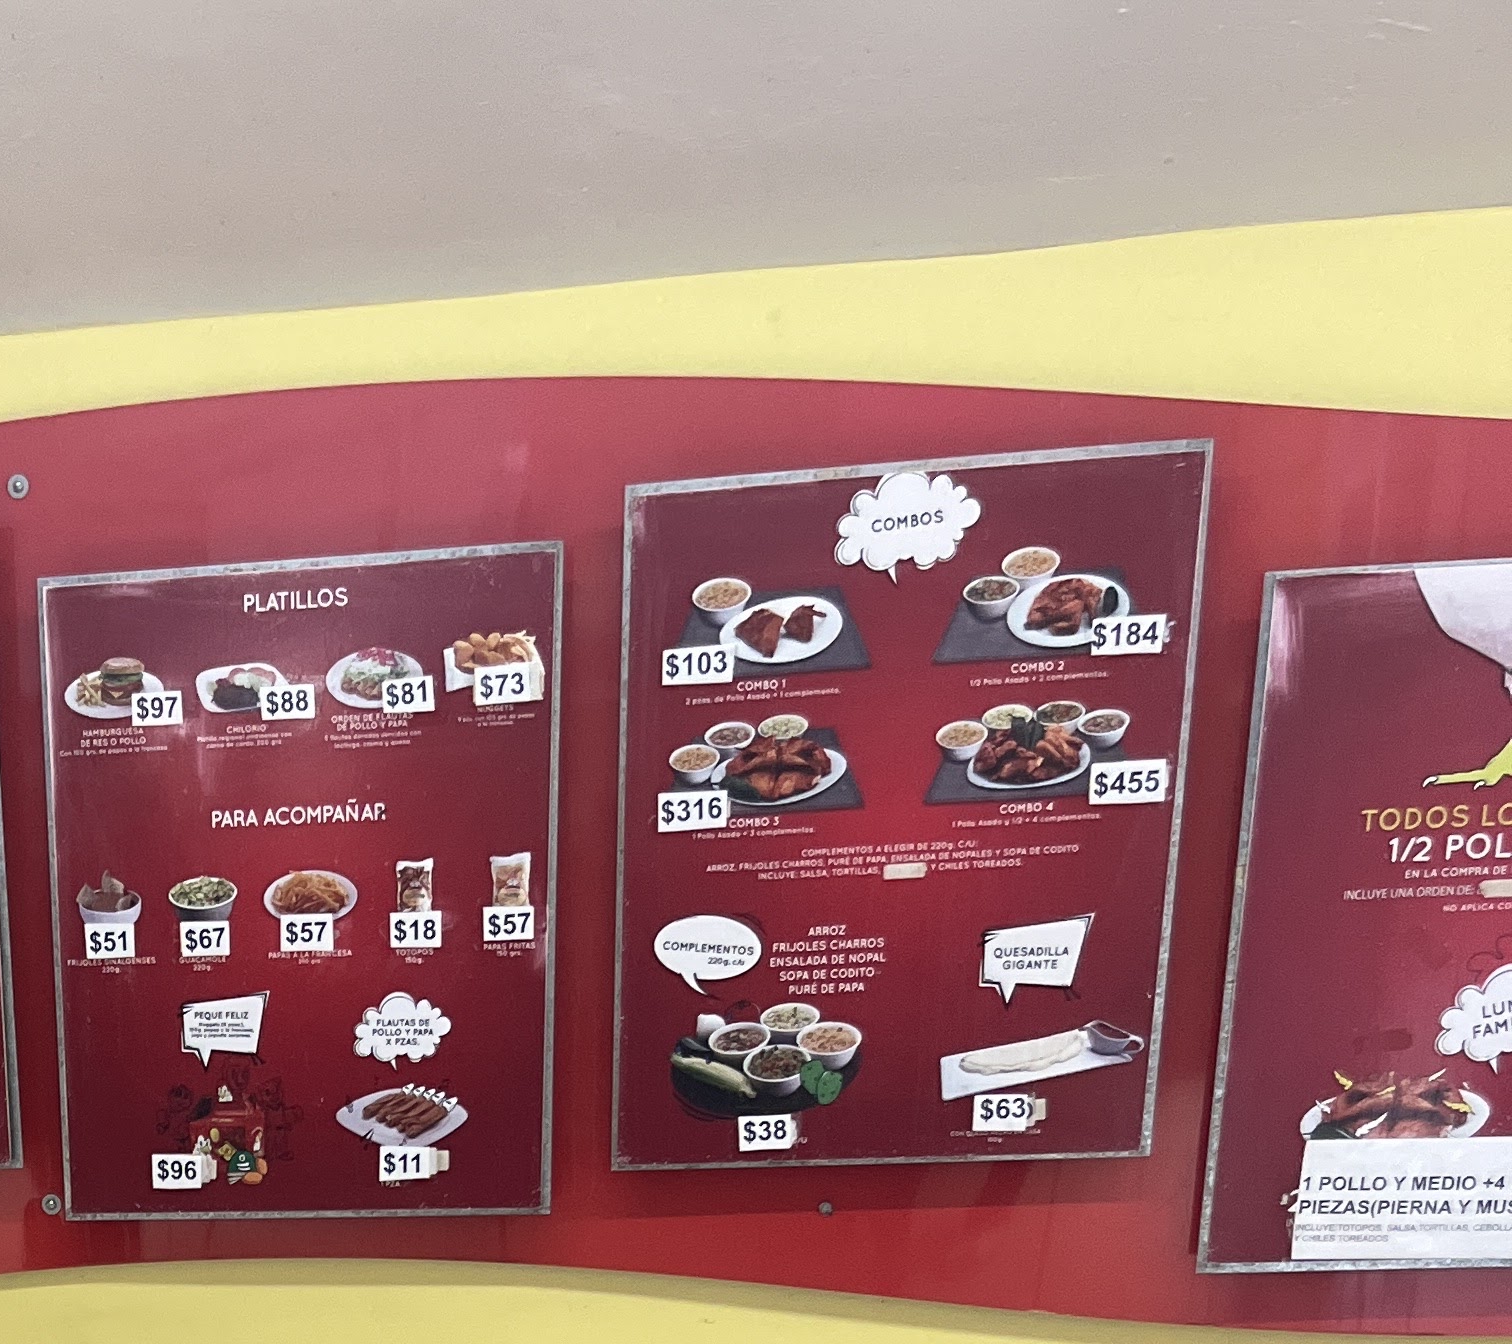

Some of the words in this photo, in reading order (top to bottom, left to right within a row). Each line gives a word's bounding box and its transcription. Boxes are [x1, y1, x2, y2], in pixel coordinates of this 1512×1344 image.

[871, 510, 944, 533] COMBOS
[243, 587, 349, 613] PLATILLOS
[1092, 621, 1159, 650] $184
[665, 650, 728, 680] $103
[1010, 661, 1055, 673] COMBO
[1057, 660, 1065, 671] 2
[386, 680, 428, 709] $81
[480, 672, 525, 699] $73
[737, 681, 779, 692] COMBO
[136, 696, 178, 722] $97
[266, 689, 309, 716] $88
[1093, 770, 1160, 799] $455
[211, 808, 259, 829] PARA
[661, 796, 723, 826] $316
[999, 803, 1042, 815] COMBO
[1045, 802, 1054, 812] 4
[1361, 804, 1470, 833] TODOS
[729, 817, 771, 829] COMBO
[772, 816, 780, 826] 3
[1388, 835, 1433, 863] 1/2
[1404, 869, 1420, 879] EN
[1423, 868, 1438, 878] LA
[1441, 866, 1489, 878] COMPRA
[1492, 865, 1508, 876] DE
[1343, 887, 1388, 901] INCLUYE
[1390, 886, 1414, 898] UNA
[1415, 885, 1455, 898] ORDEN
[285, 921, 327, 945] $57
[393, 919, 437, 943] $18
[488, 912, 531, 937] $57
[807, 925, 847, 936] ARROZ
[89, 930, 128, 954] $51
[184, 927, 226, 952] $67
[662, 940, 755, 956] COMPLEMENTOS
[772, 940, 827, 953] FRIJOLES
[829, 937, 885, 950] CHARROS
[769, 954, 828, 968] ENSALADA
[830, 953, 846, 965] DE
[848, 951, 886, 963] NOPAL
[993, 946, 1069, 958] QUESADILLA
[779, 969, 810, 982] SOPA
[812, 969, 827, 980] DE
[829, 966, 875, 979] CODITO
[1002, 959, 1059, 971] GIGANTE
[788, 982, 818, 995] PURÉ
[820, 983, 835, 994] DE
[838, 981, 865, 993] PAPA
[194, 1011, 223, 1021] PEQUE
[225, 1011, 249, 1020] FELIZ
[376, 1018, 416, 1027] FLAUTAS
[418, 1018, 430, 1027] DE
[372, 1028, 402, 1037] POLLO
[405, 1028, 411, 1036] Y
[413, 1027, 434, 1036] PAPA
[385, 1038, 392, 1046] X
[979, 1097, 1026, 1123] $63
[743, 1119, 787, 1144] $38
[157, 1159, 197, 1182] $96
[383, 1152, 421, 1175] $11
[1303, 1176, 1312, 1191] 1
[1318, 1176, 1387, 1191] POLLO
[1394, 1176, 1407, 1191] Y
[1411, 1175, 1477, 1191] MEDIO
[1482, 1175, 1506, 1191] +4
[1298, 1199, 1452, 1218] PIEZAS(PIERNA
[1458, 1199, 1472, 1215] Y
